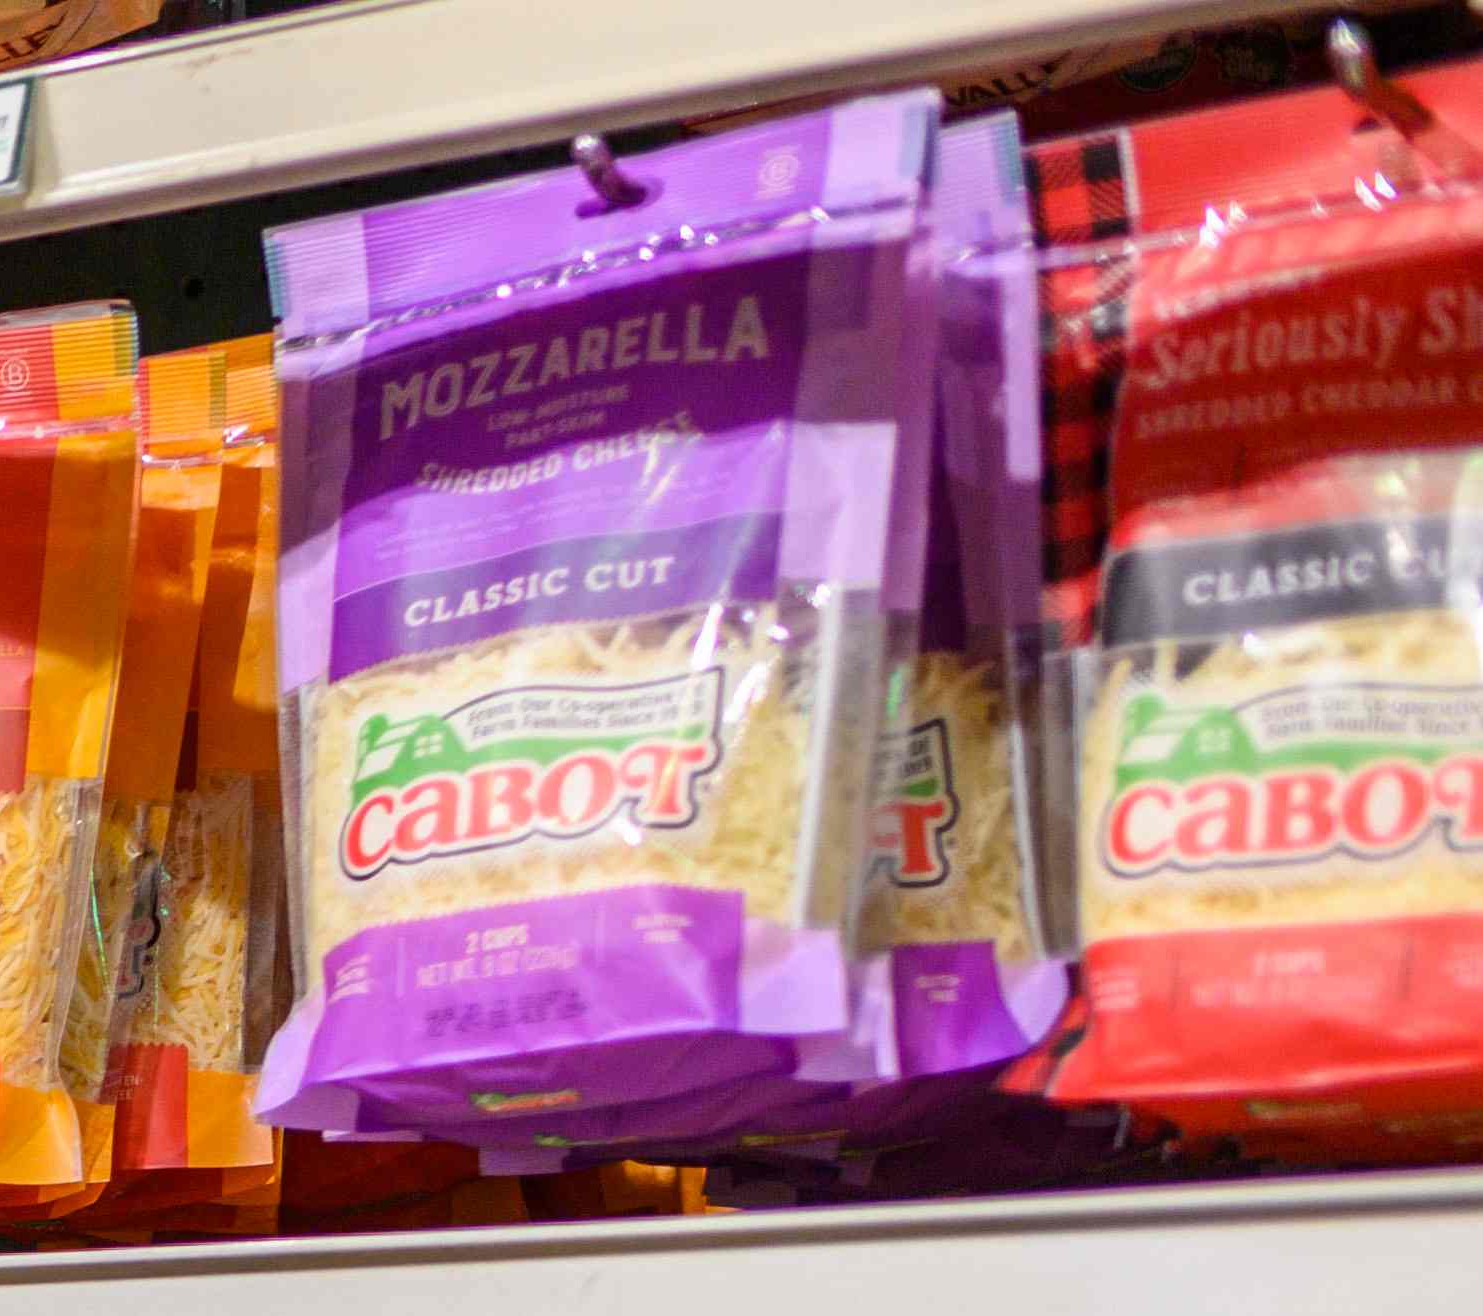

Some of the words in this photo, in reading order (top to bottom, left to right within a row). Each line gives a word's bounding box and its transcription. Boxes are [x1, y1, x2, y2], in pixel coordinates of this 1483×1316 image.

[378, 295, 771, 441] MOZZARELLA
[1140, 298, 1408, 392] Seriously
[414, 452, 566, 496] SHREDDED
[404, 567, 569, 629] CLASSIC
[584, 556, 677, 588] CUT
[1181, 550, 1377, 606] CLASSIC
